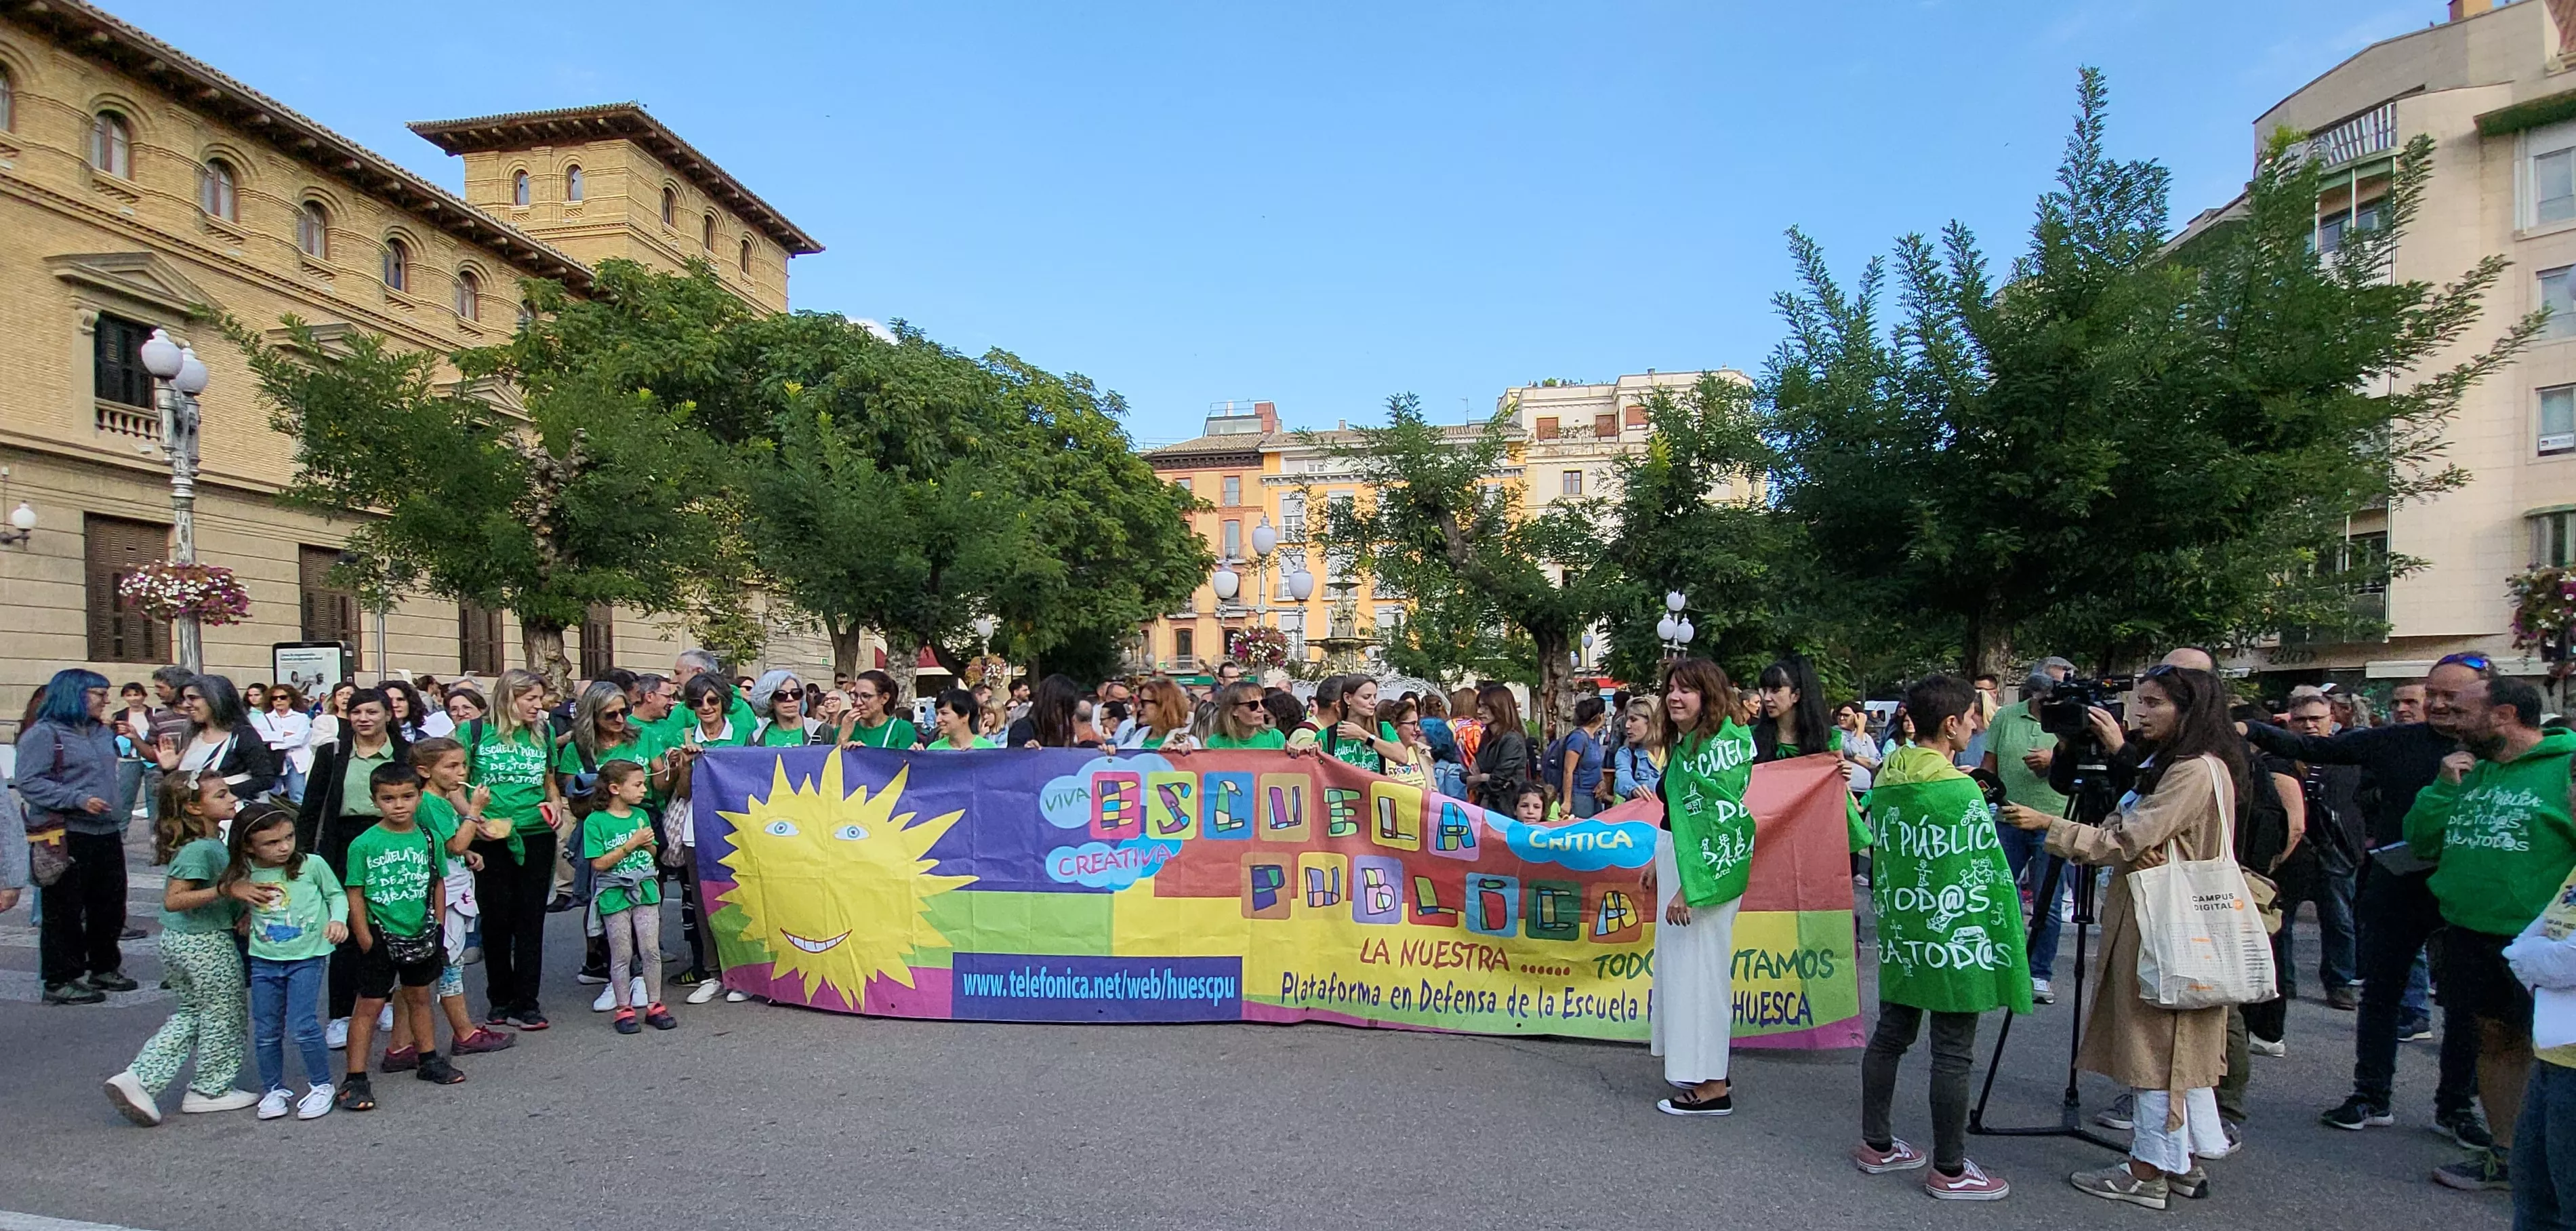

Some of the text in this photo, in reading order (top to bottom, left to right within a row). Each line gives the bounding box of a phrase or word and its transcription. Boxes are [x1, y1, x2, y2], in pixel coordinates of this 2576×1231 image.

[490, 763, 506, 771] DE
[1045, 788, 1090, 813] VIVA
[1097, 780, 1477, 851] ESCUELA
[1058, 844, 1174, 876] CREATIVA
[380, 876, 396, 886] DE
[2192, 893, 2234, 902] CAMPUS
[2194, 902, 2234, 911] DIGITAL
[1359, 937, 1391, 965] LA
[1400, 938, 1510, 973] NUESTRA
[963, 966, 1235, 1007] www.telefonica.net/web/huescpu
[1282, 971, 1381, 1007] Plataforma
[1390, 986, 1412, 1012] en
[1419, 977, 1497, 1016] Defensa
[1507, 984, 1530, 1018] de
[1538, 985, 1554, 1019] la
[1561, 986, 1639, 1024] Escuela
[1732, 990, 1814, 1028] HUESCA
